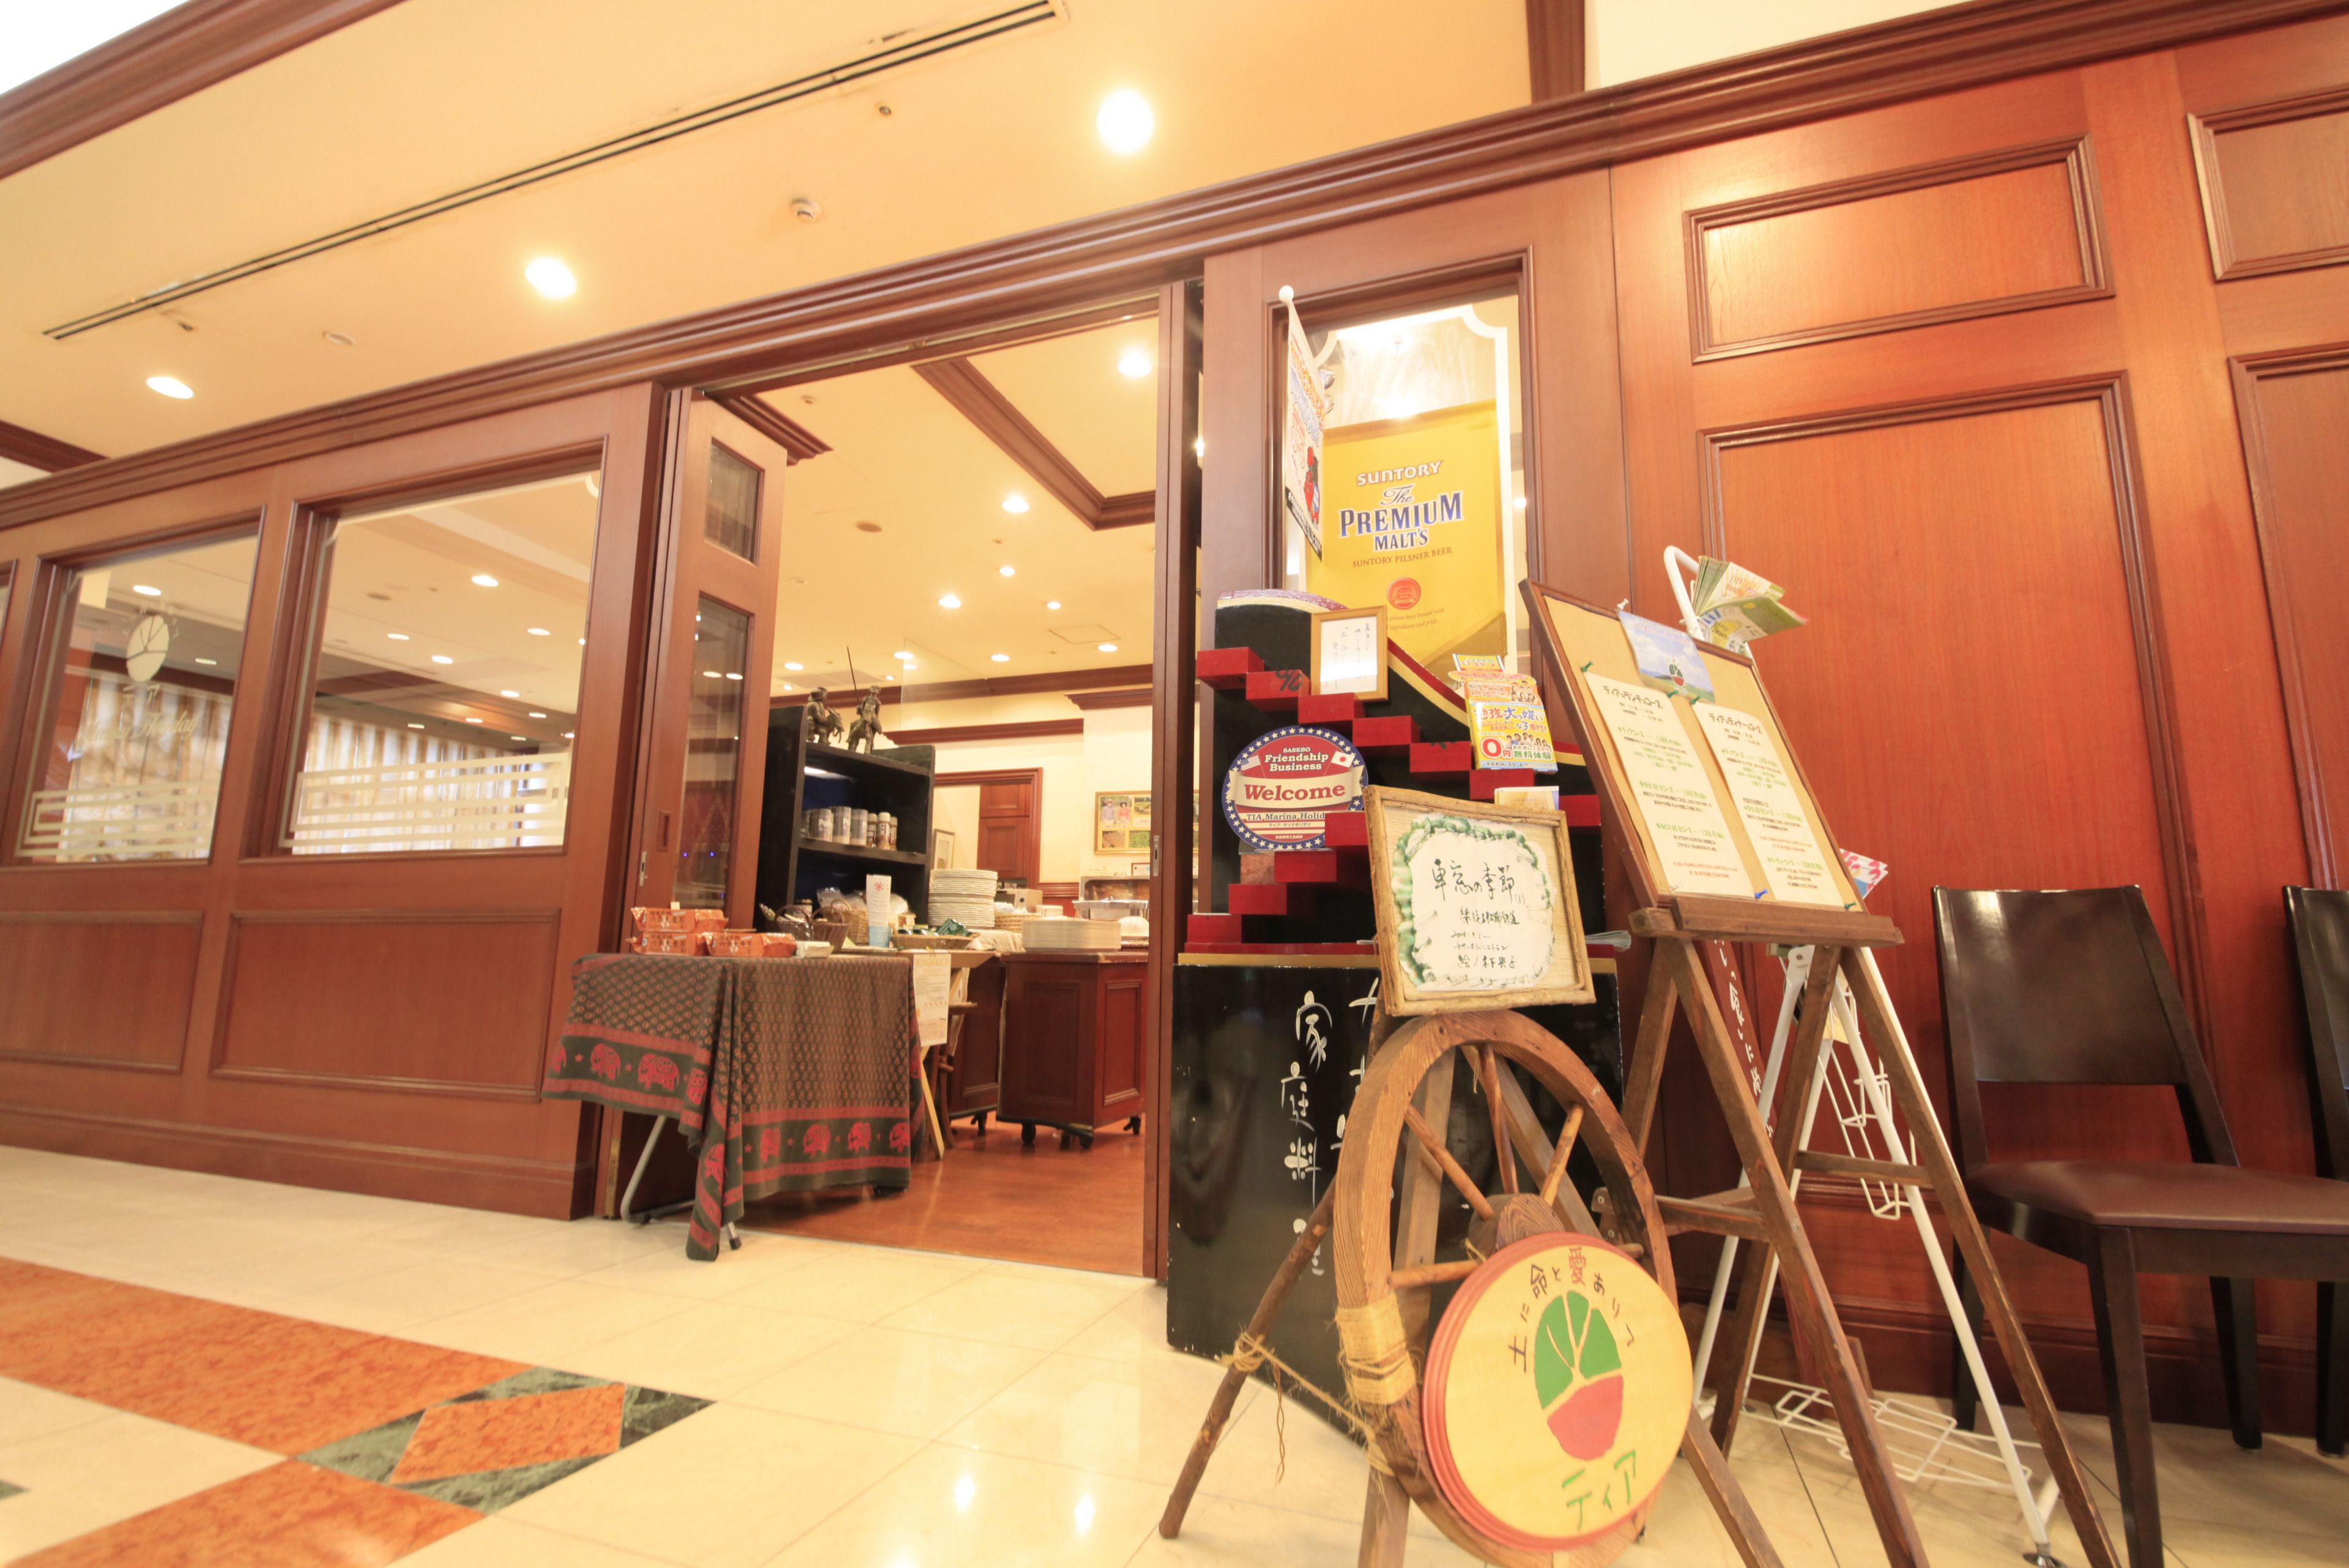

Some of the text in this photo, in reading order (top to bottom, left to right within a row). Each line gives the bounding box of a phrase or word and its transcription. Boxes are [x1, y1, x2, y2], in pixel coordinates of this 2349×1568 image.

[1356, 460, 1441, 486] SUNTORY
[1380, 484, 1416, 505] The
[1340, 492, 1463, 537] PREMIUM
[1374, 528, 1428, 551] MALT'S
[1352, 547, 1453, 568] SUNTORY PILSNER BEER
[1264, 752, 1329, 763] Friendship
[1269, 763, 1322, 772] Business
[1244, 784, 1345, 801] Welcome
[1562, 1450, 1636, 1531] ティア
